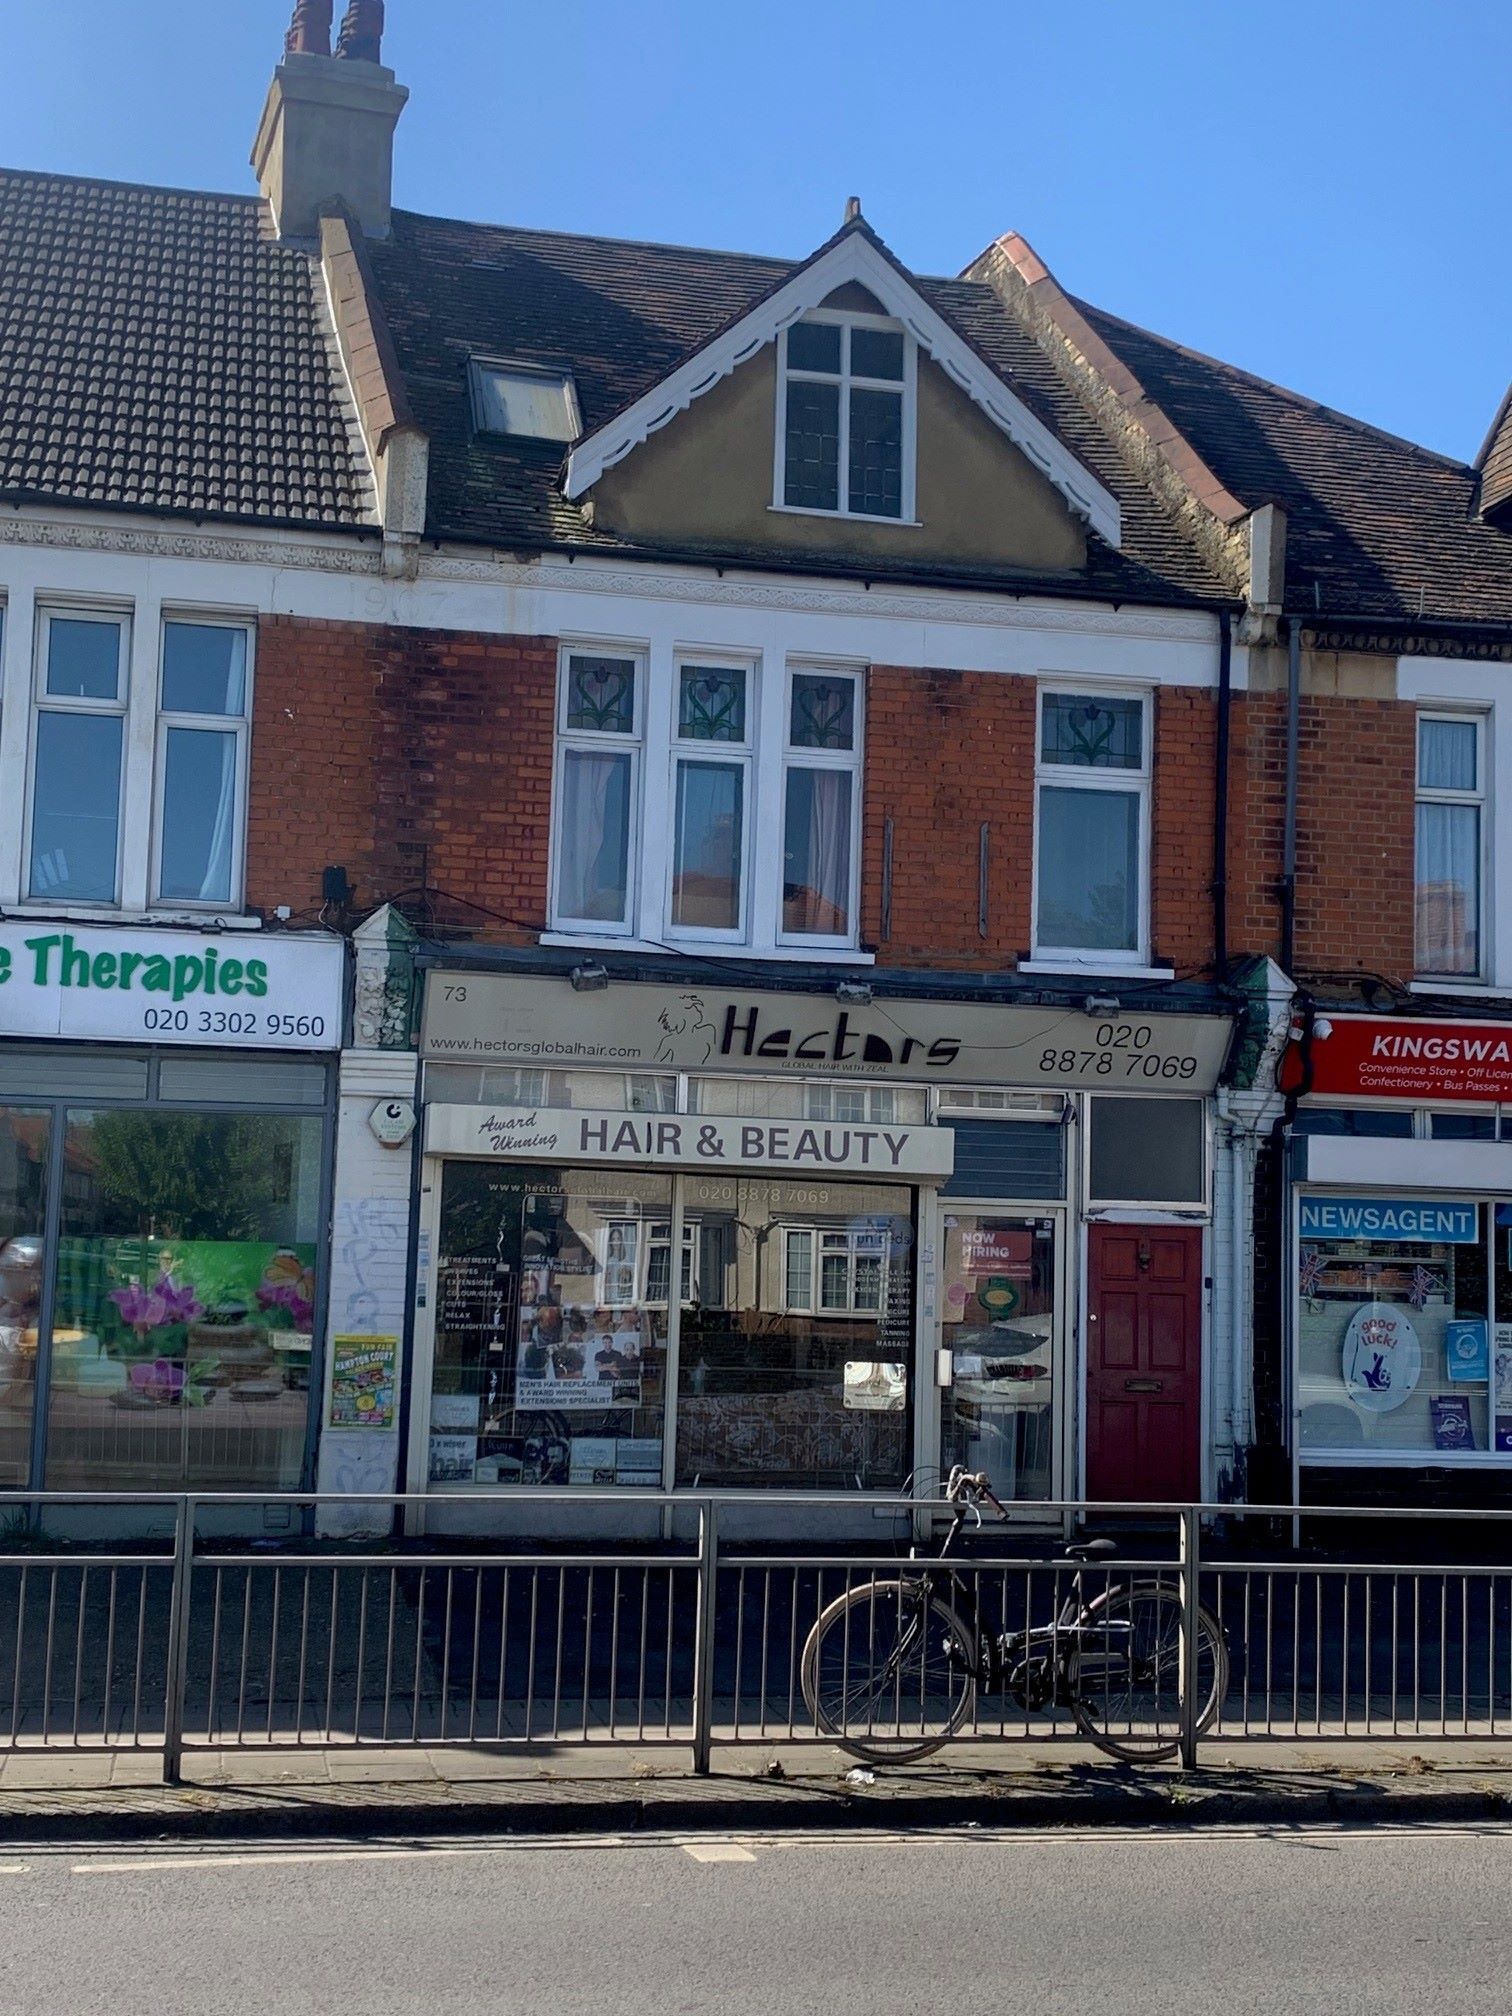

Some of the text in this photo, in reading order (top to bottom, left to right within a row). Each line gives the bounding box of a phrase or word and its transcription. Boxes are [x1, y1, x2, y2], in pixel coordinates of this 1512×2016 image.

[25, 934, 268, 1002] Therapies
[444, 986, 467, 1002] 73
[144, 1008, 325, 1037] 020 3302 9560
[721, 1005, 962, 1066] Hectors
[1097, 1023, 1152, 1049] 020
[430, 1036, 641, 1058] www.hectorsglobalhair.com
[1372, 1035, 1511, 1062] KINGSWA
[781, 1061, 889, 1073] GLOBAL HAIR WITH ZEAL
[1039, 1048, 1198, 1080] 8878 7069
[1359, 1062, 1426, 1076] Convenience
[1428, 1065, 1457, 1077] Store
[1467, 1066, 1485, 1078] Off
[1360, 1075, 1500, 1092] Confectionery Bus Passes
[478, 1112, 536, 1134] Award
[490, 1132, 560, 1152] Winning
[580, 1118, 910, 1166] HAIR & BEAUTY
[699, 1186, 829, 1204] 020 8878 7069
[1301, 1205, 1471, 1233] NEWSAGENT
[962, 1232, 995, 1244] NOW
[962, 1246, 1010, 1258] HIRING
[1361, 1319, 1397, 1335] good
[1361, 1333, 1398, 1349] luck!
